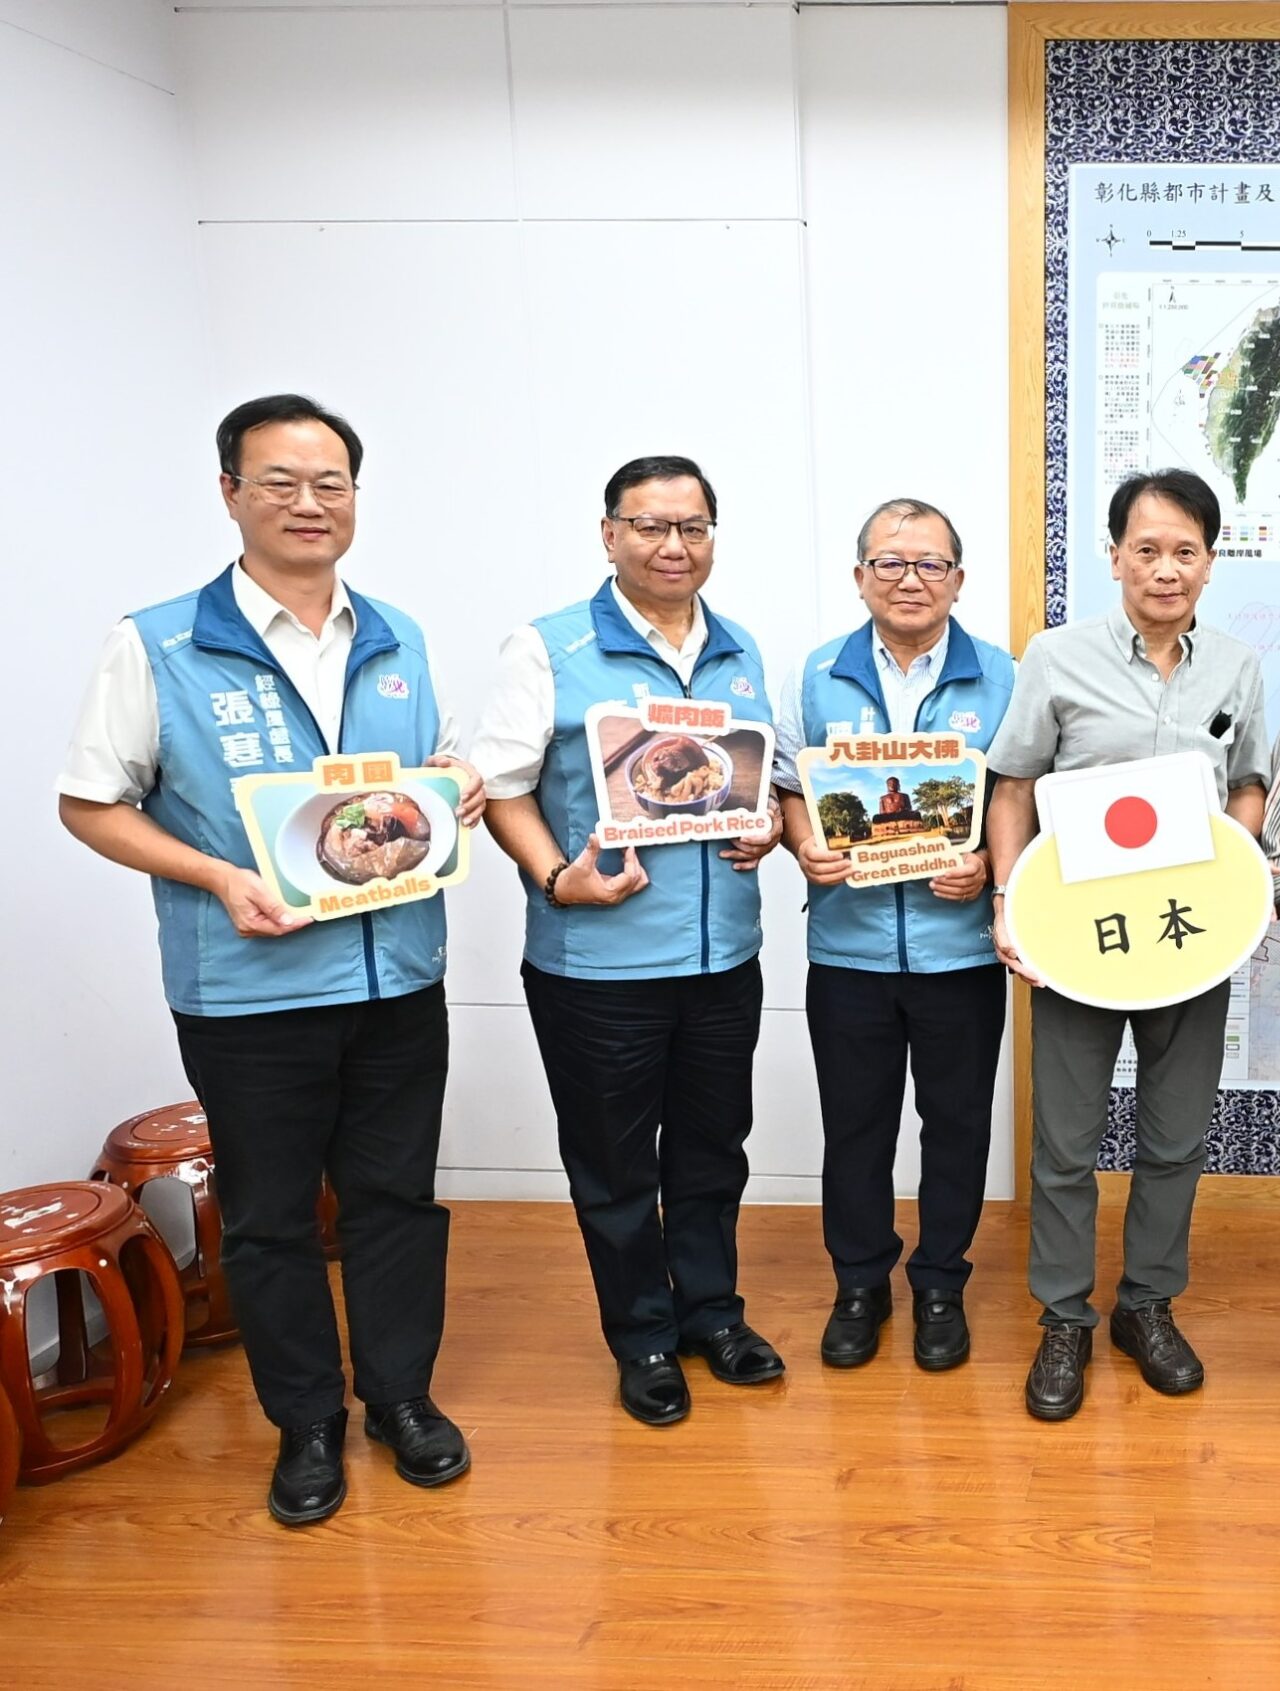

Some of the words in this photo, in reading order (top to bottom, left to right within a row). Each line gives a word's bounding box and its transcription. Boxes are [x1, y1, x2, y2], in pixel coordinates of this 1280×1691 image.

[1239, 231, 1245, 239] 5
[829, 739, 960, 761] 八卦山大佛
[603, 822, 678, 842] Braised
[680, 817, 724, 836] Pork
[727, 814, 765, 831] Rice
[857, 842, 945, 864] Baguashan
[850, 866, 897, 883] Great
[899, 857, 957, 876] Buddha
[319, 877, 431, 914] Meatballs
[1094, 899, 1207, 955] 日本
